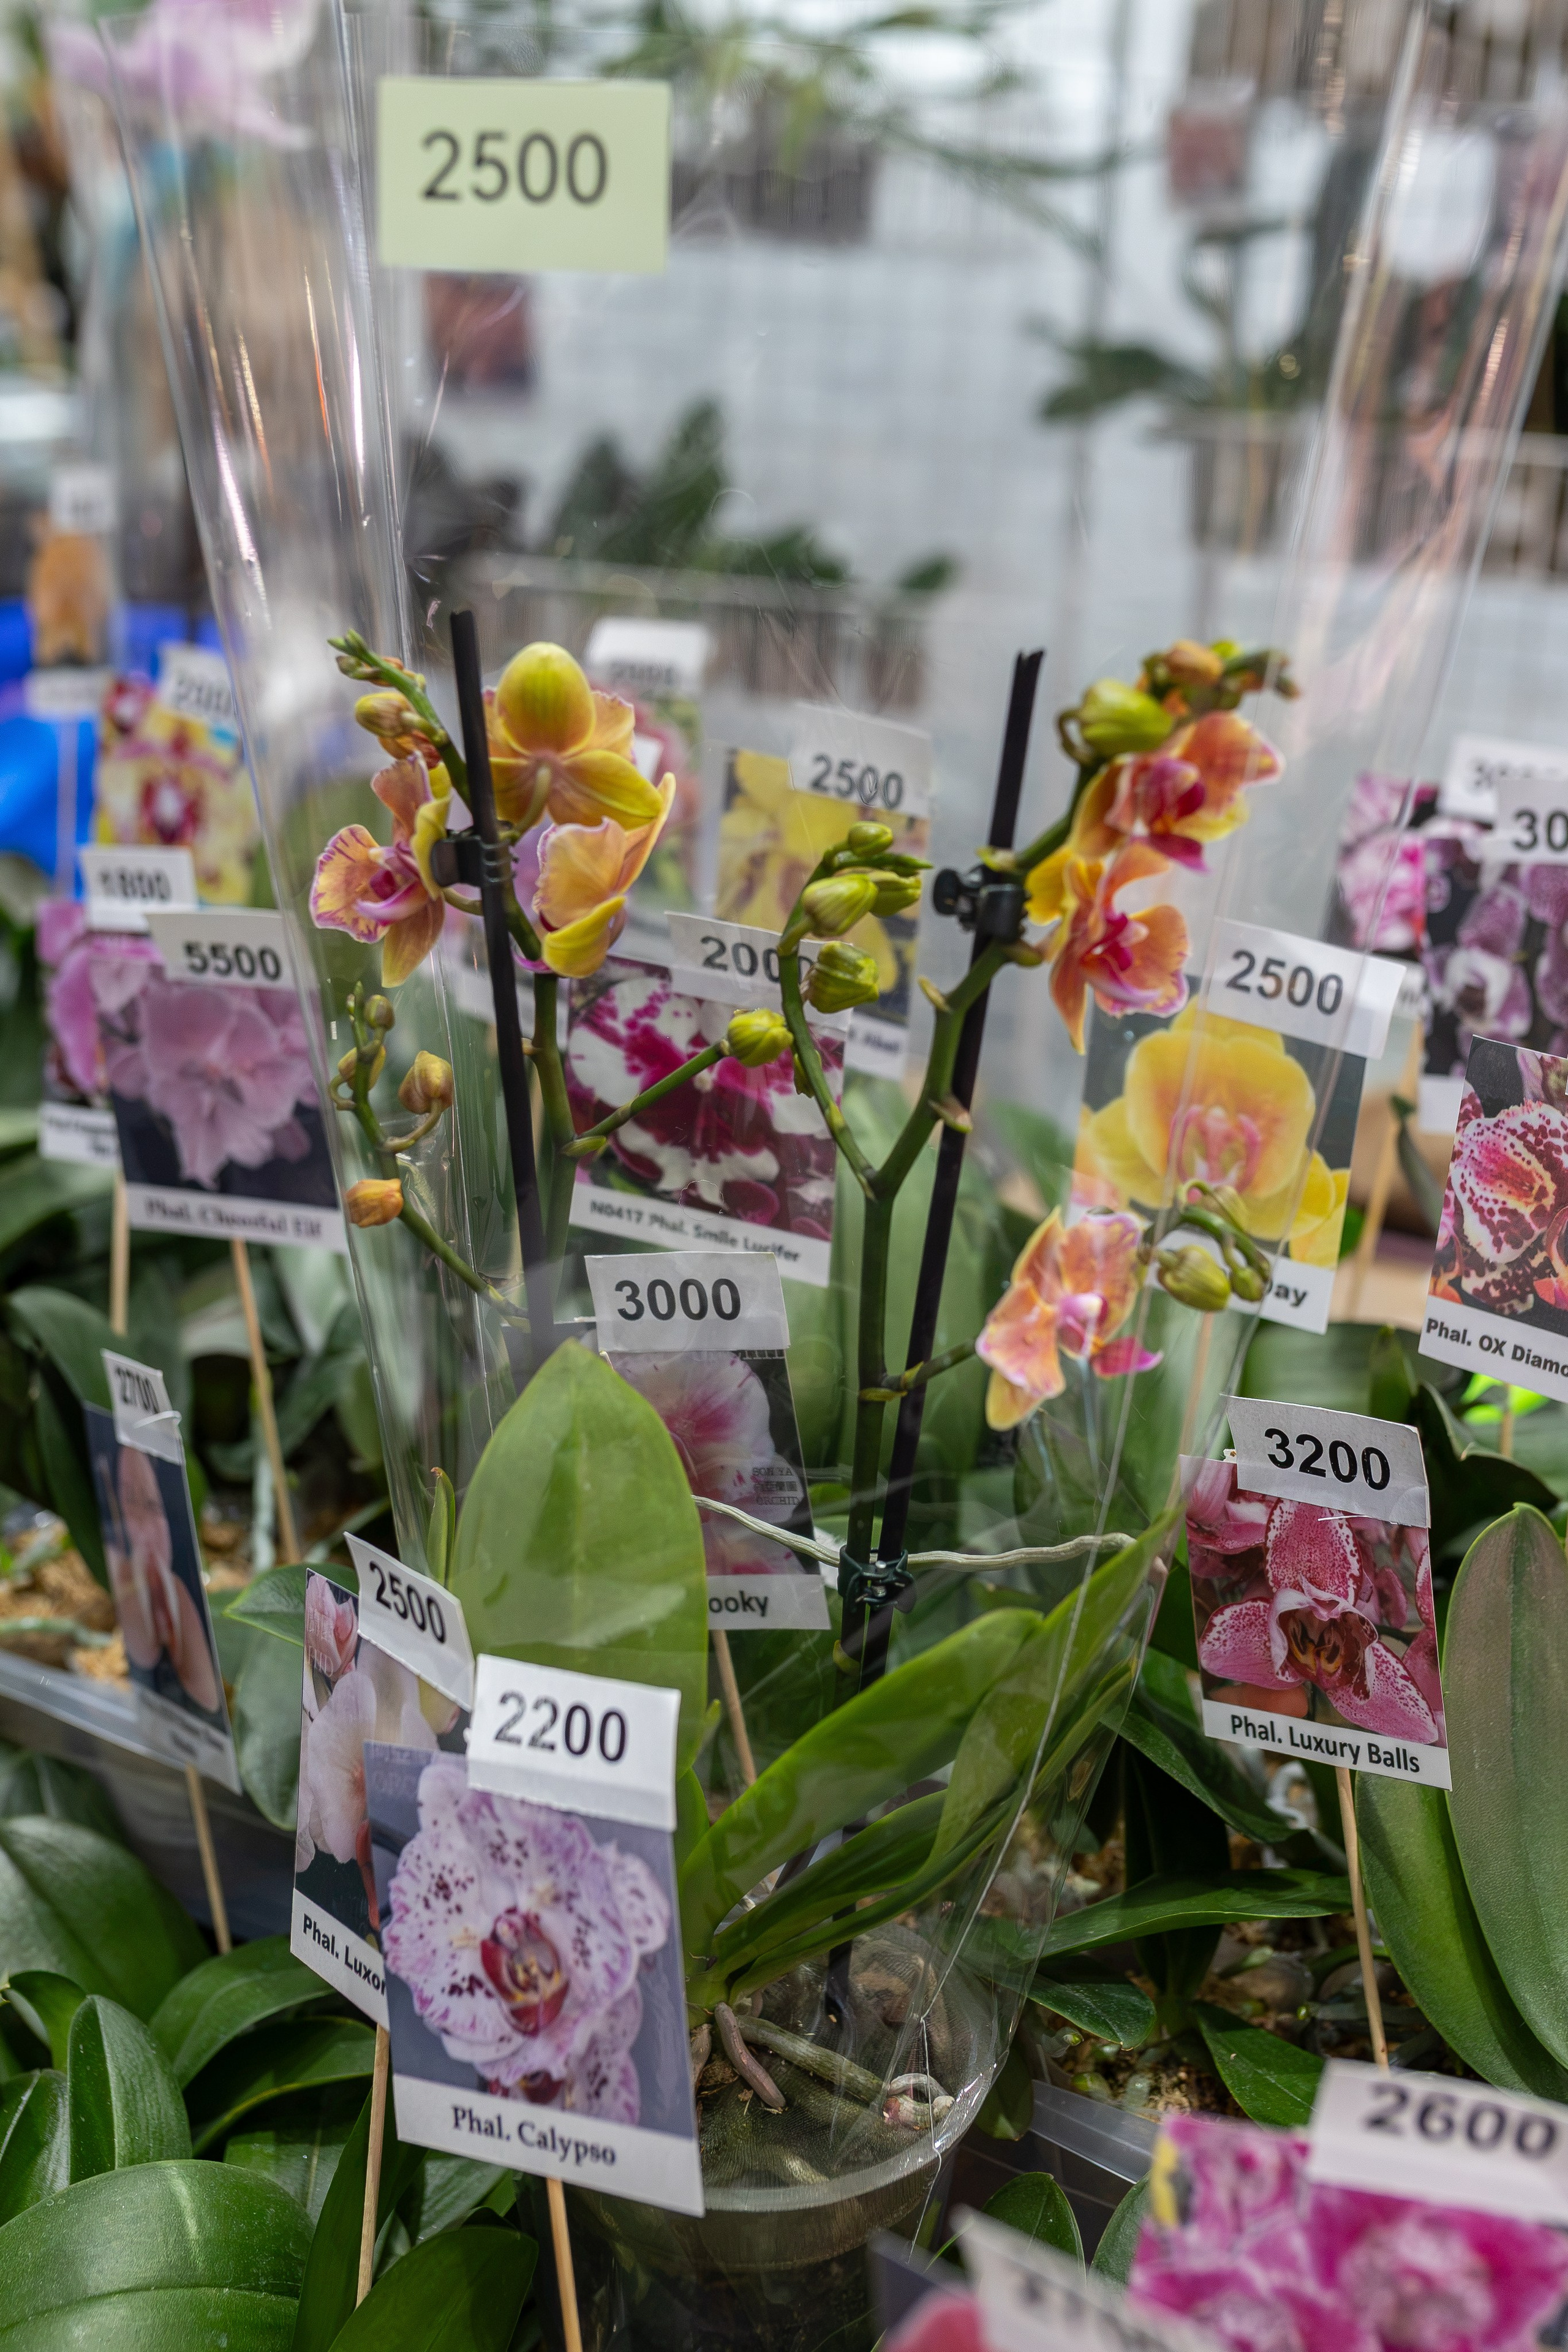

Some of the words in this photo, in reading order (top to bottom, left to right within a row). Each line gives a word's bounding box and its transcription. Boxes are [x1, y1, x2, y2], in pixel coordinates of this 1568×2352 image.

[421, 129, 608, 205] 2500
[810, 753, 904, 810] 2500
[184, 941, 282, 980] 5500
[1225, 949, 1343, 1016] 2500
[648, 1212, 689, 1237] Phal.
[693, 1223, 738, 1248] Smile
[742, 1236, 800, 1263] Lucifer
[614, 1278, 741, 1321] 3000
[1426, 1317, 1471, 1347] Phal.
[1479, 1334, 1507, 1357] OX
[1264, 1428, 1390, 1490] 3200
[369, 1561, 447, 1645] 2500
[494, 1691, 628, 1763] 2200
[1231, 1714, 1283, 1744] Phal.
[1289, 1726, 1361, 1765] Luxury
[1367, 1742, 1420, 1773] Balls
[303, 1913, 339, 1960] Phal.
[451, 2103, 511, 2142] Phal.
[517, 2120, 616, 2166] Calypso
[1363, 2081, 1558, 2162] 2600
